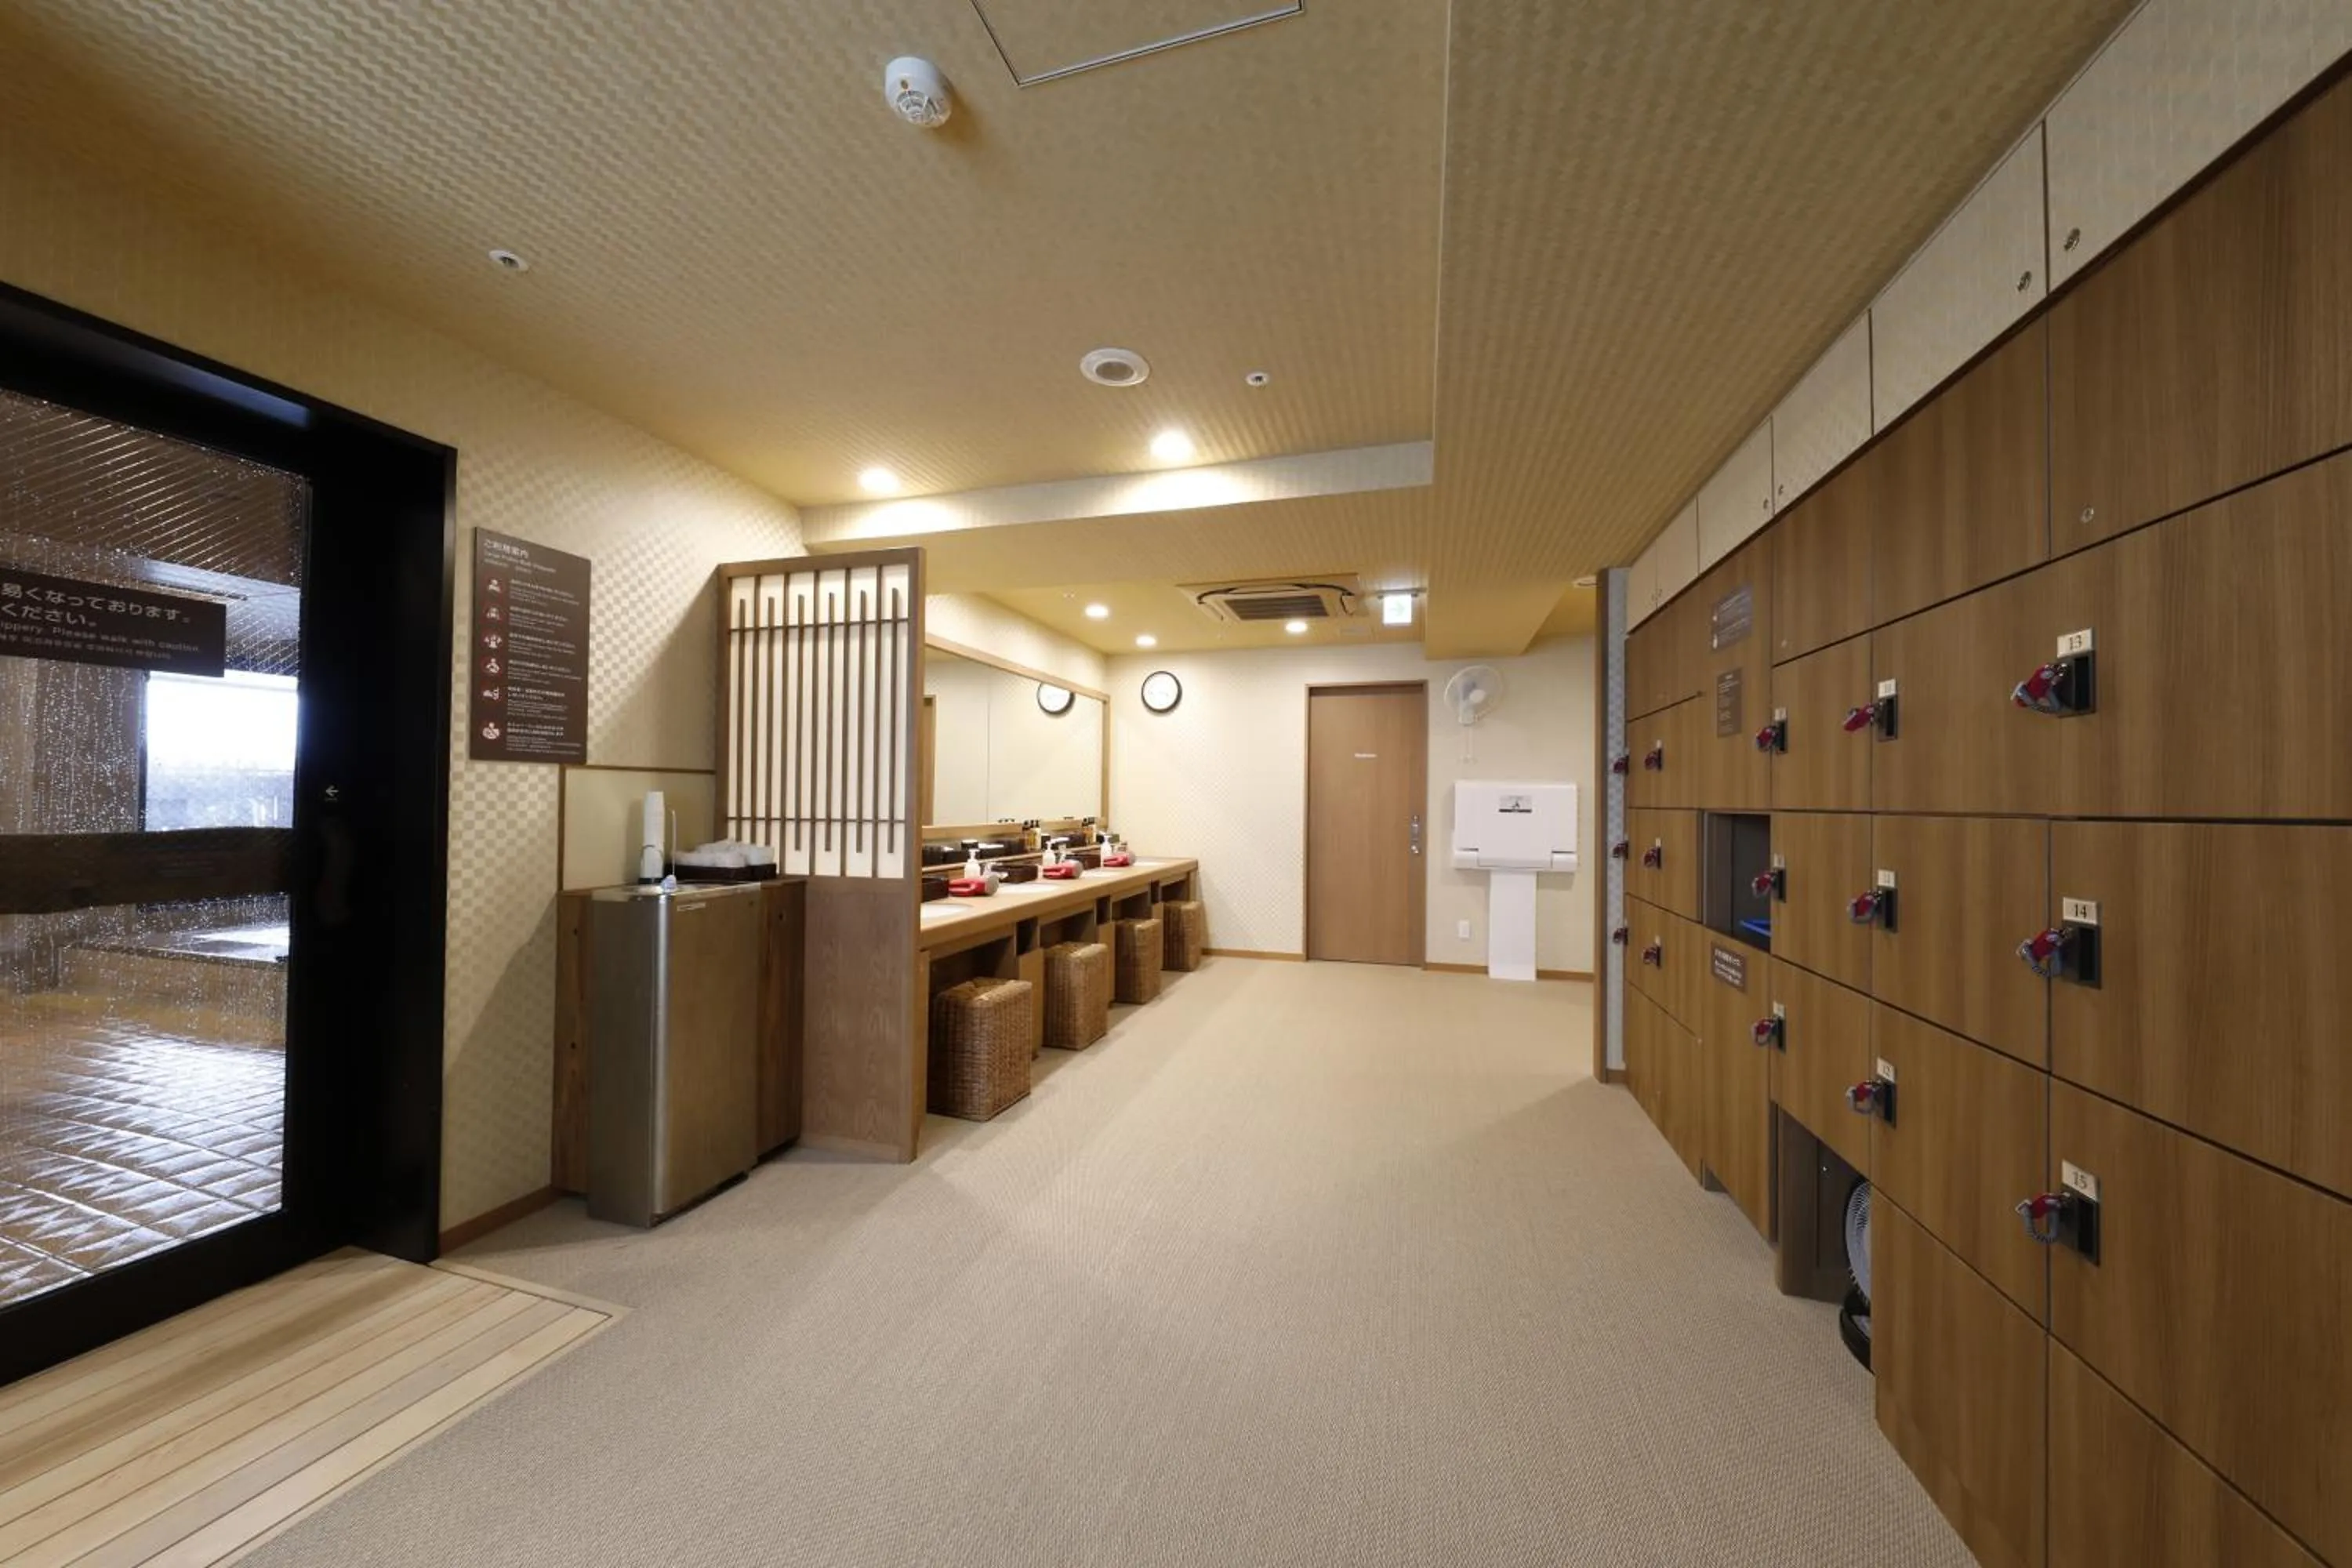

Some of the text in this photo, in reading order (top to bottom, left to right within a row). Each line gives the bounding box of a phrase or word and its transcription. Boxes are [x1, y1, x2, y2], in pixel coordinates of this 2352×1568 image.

[2, 603, 96, 625] ください。
[2069, 634, 2082, 651] 13
[2074, 902, 2087, 919] 14
[2072, 1171, 2087, 1189] 15
